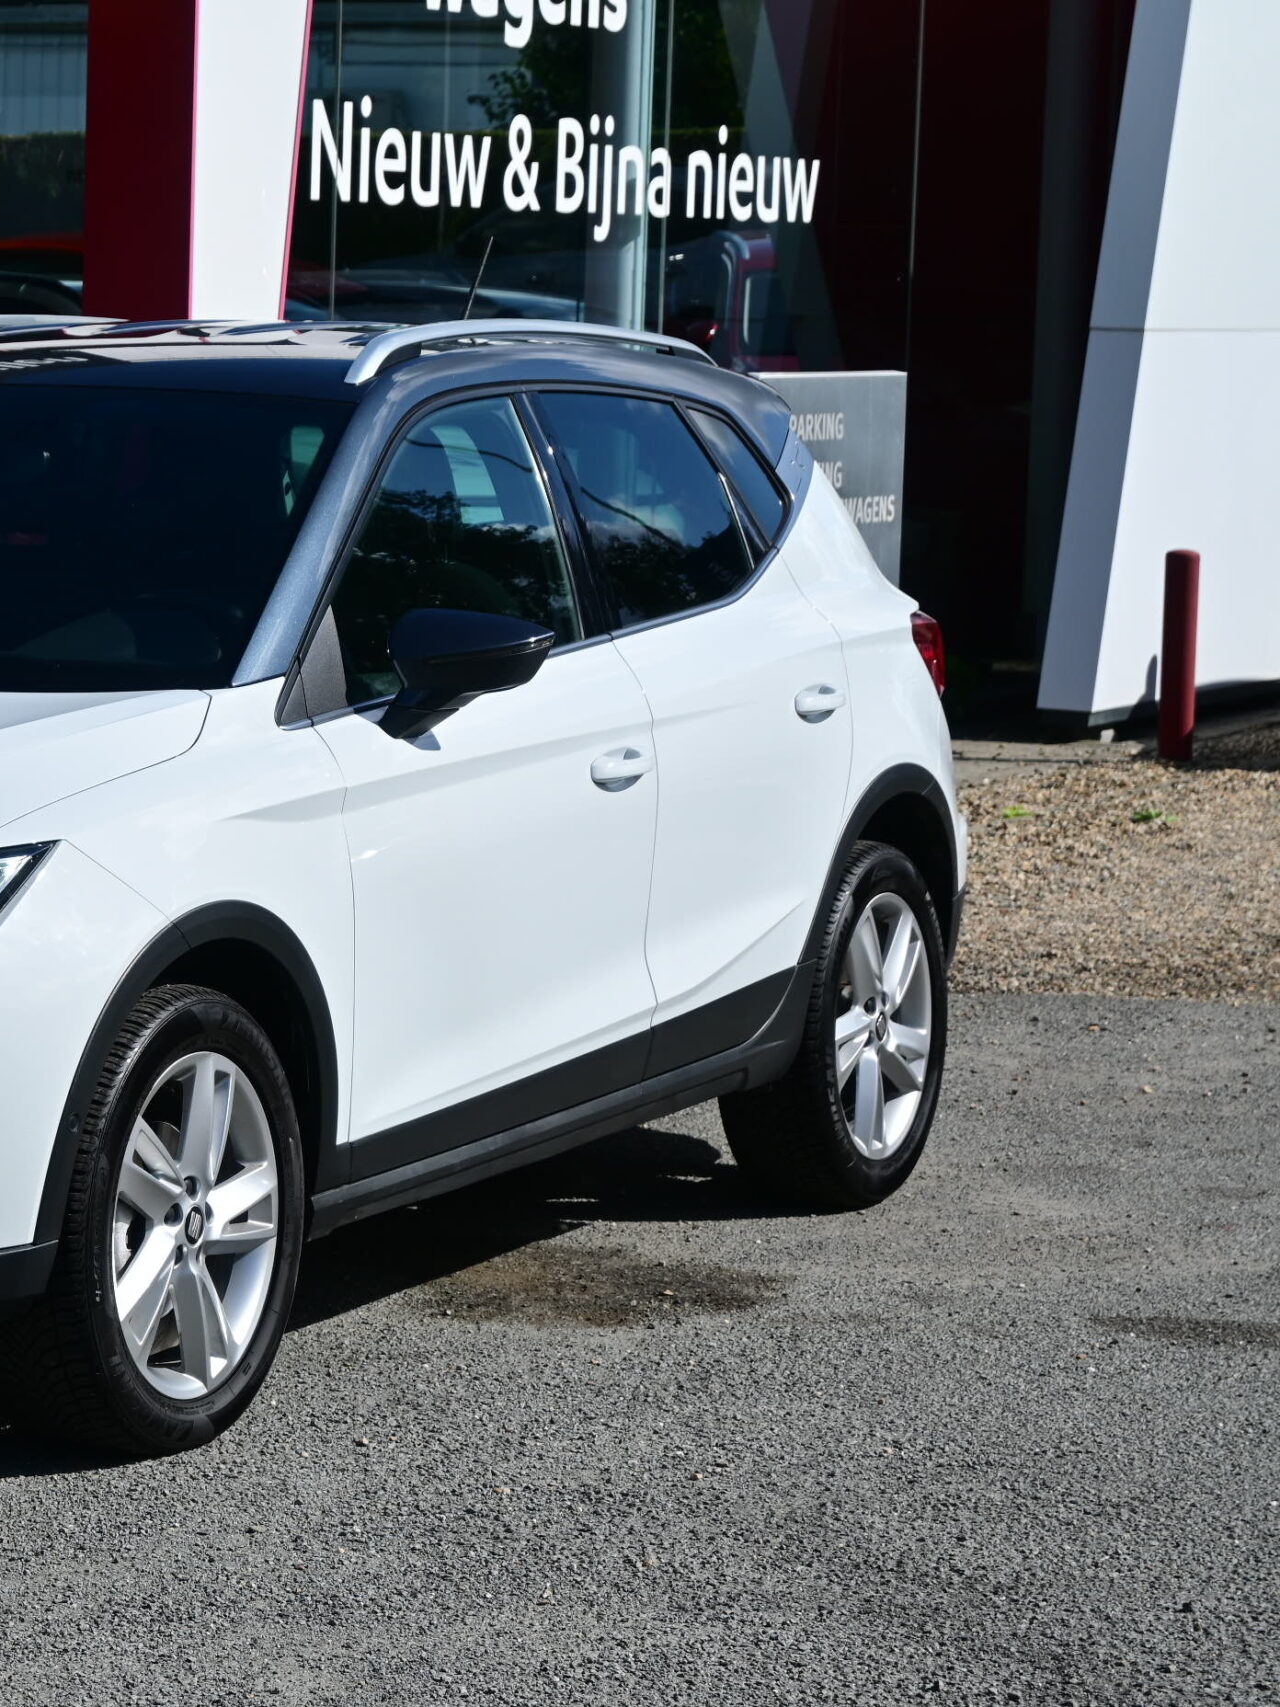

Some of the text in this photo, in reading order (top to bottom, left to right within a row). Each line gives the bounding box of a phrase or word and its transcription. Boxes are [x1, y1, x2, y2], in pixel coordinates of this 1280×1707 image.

[310, 95, 821, 242] Nieuw & Bijna nieuw
[789, 412, 844, 441] PARKING
